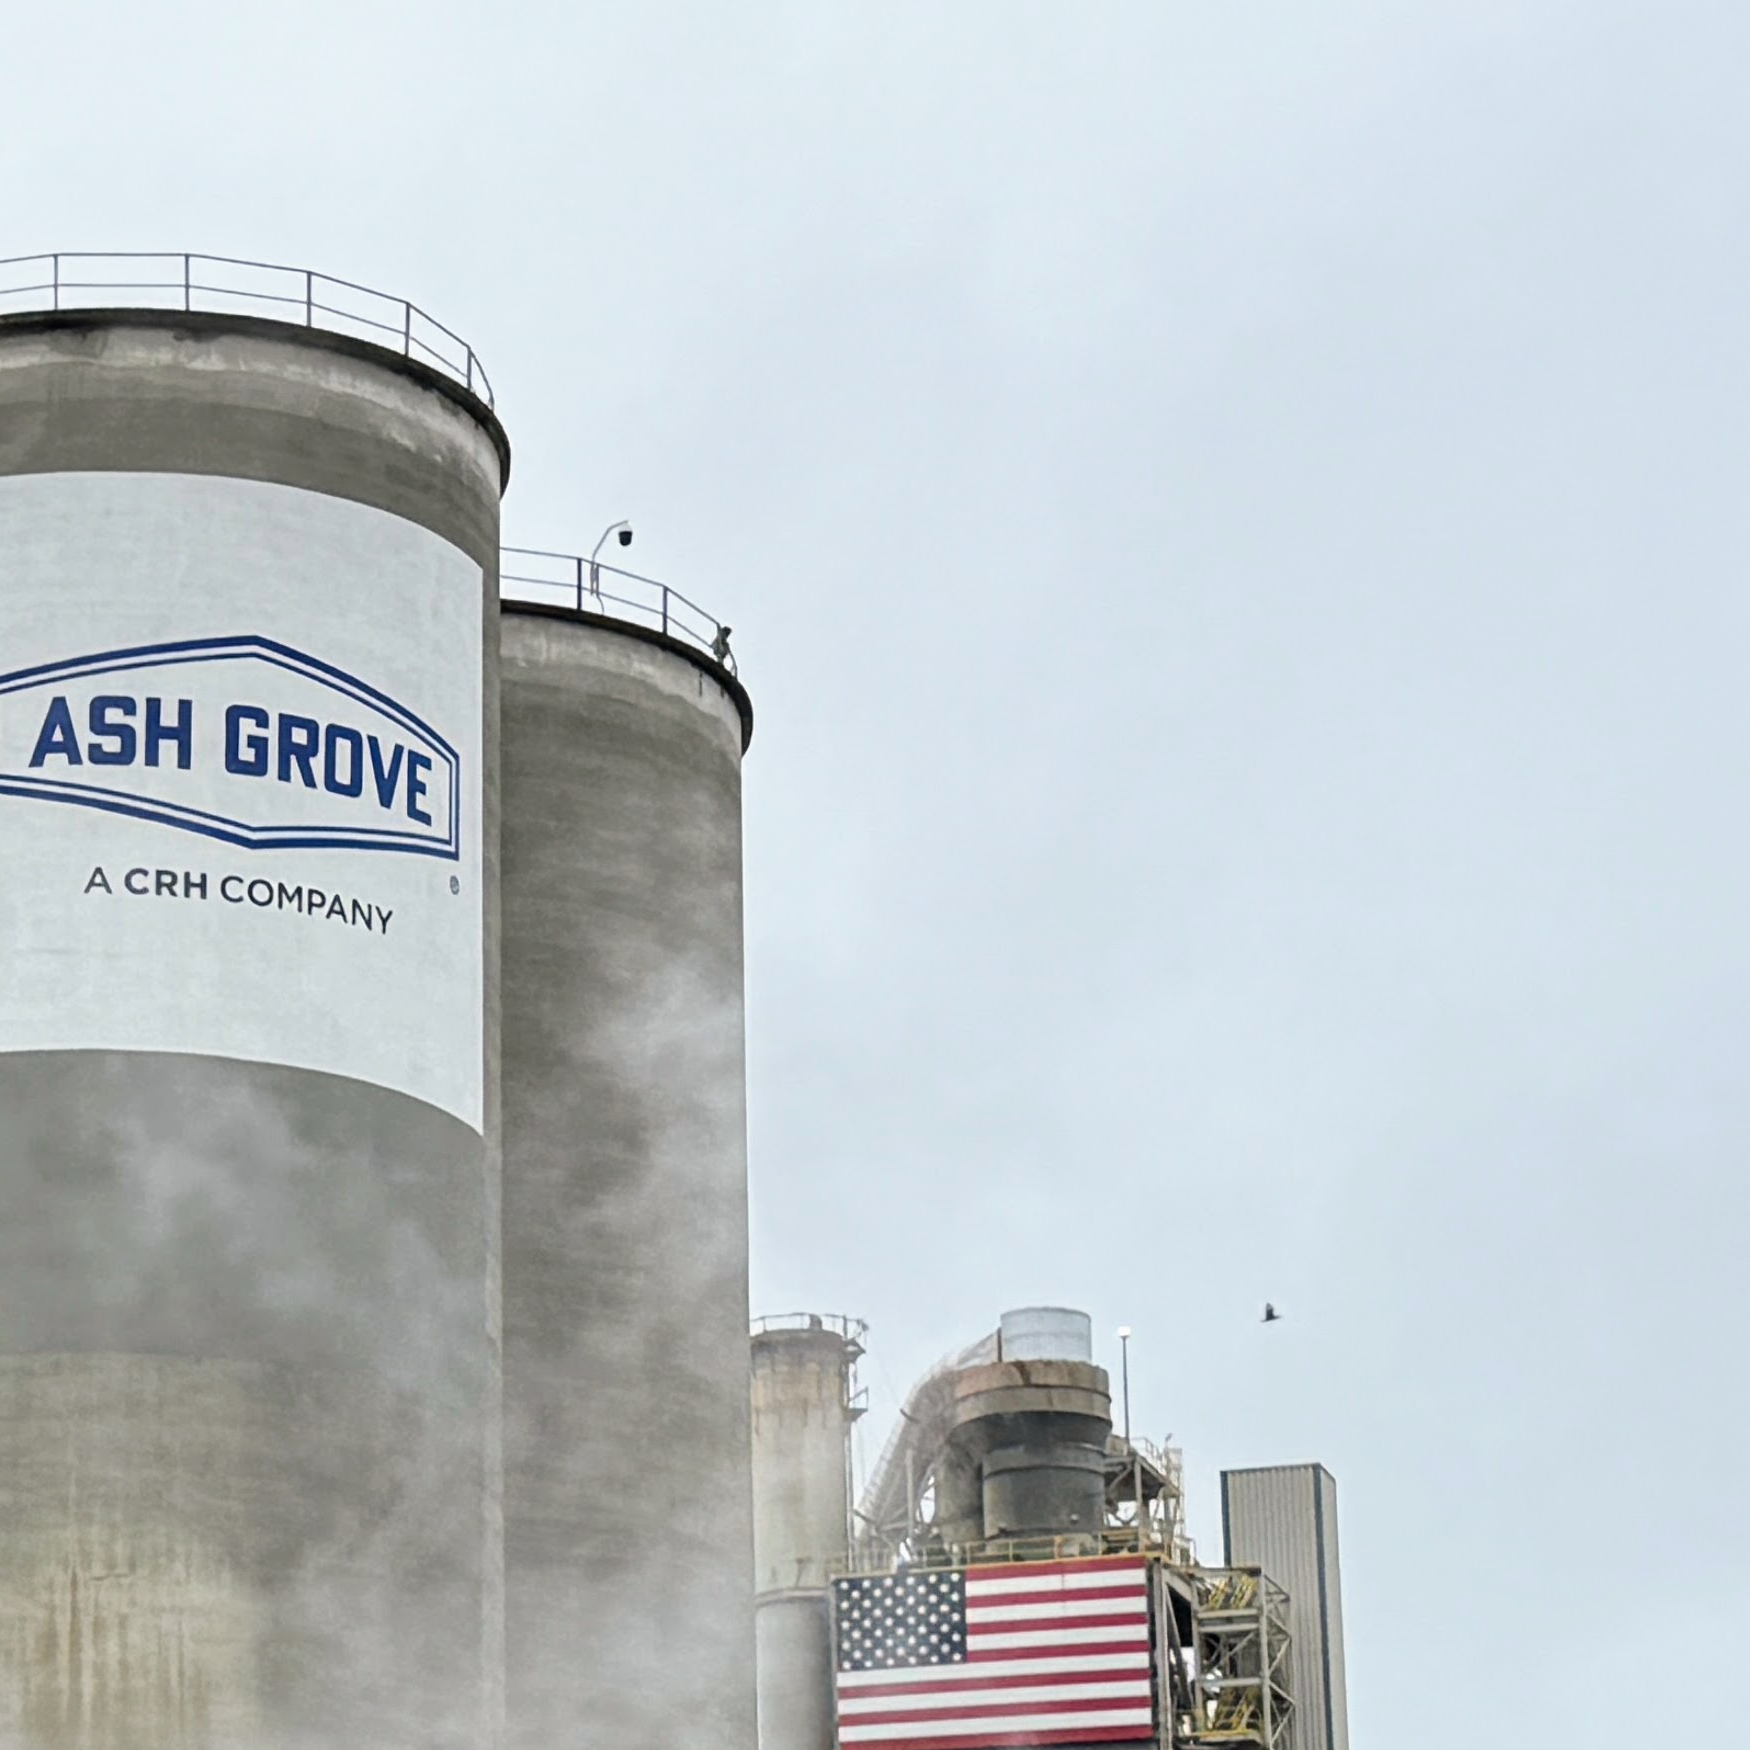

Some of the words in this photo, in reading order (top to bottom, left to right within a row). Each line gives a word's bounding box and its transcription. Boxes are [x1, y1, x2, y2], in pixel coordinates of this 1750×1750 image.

[28, 695, 193, 770] ASH
[224, 704, 433, 827] GROVE
[83, 866, 113, 895] A
[123, 867, 208, 900] CRH
[220, 875, 394, 934] COMPANY
